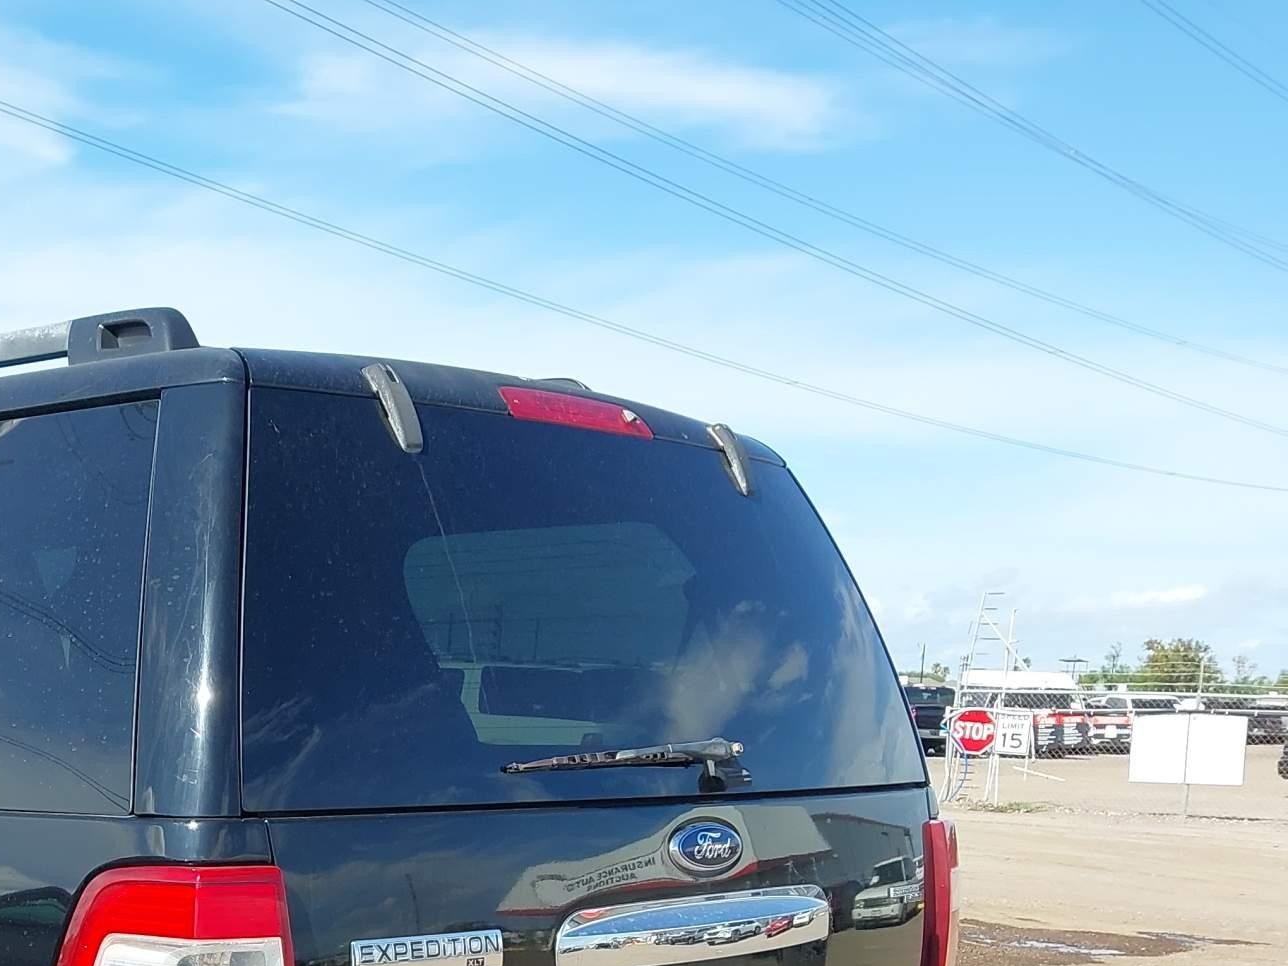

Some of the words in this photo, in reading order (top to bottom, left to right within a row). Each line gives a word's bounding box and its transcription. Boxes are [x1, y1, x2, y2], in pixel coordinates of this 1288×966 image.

[953, 721, 995, 741] STOP
[1002, 722, 1025, 730] LIMIT
[1001, 732, 1023, 749] 15
[694, 831, 731, 859] Ford
[360, 934, 500, 963] EXPEDITION
[467, 958, 484, 966] XLT
